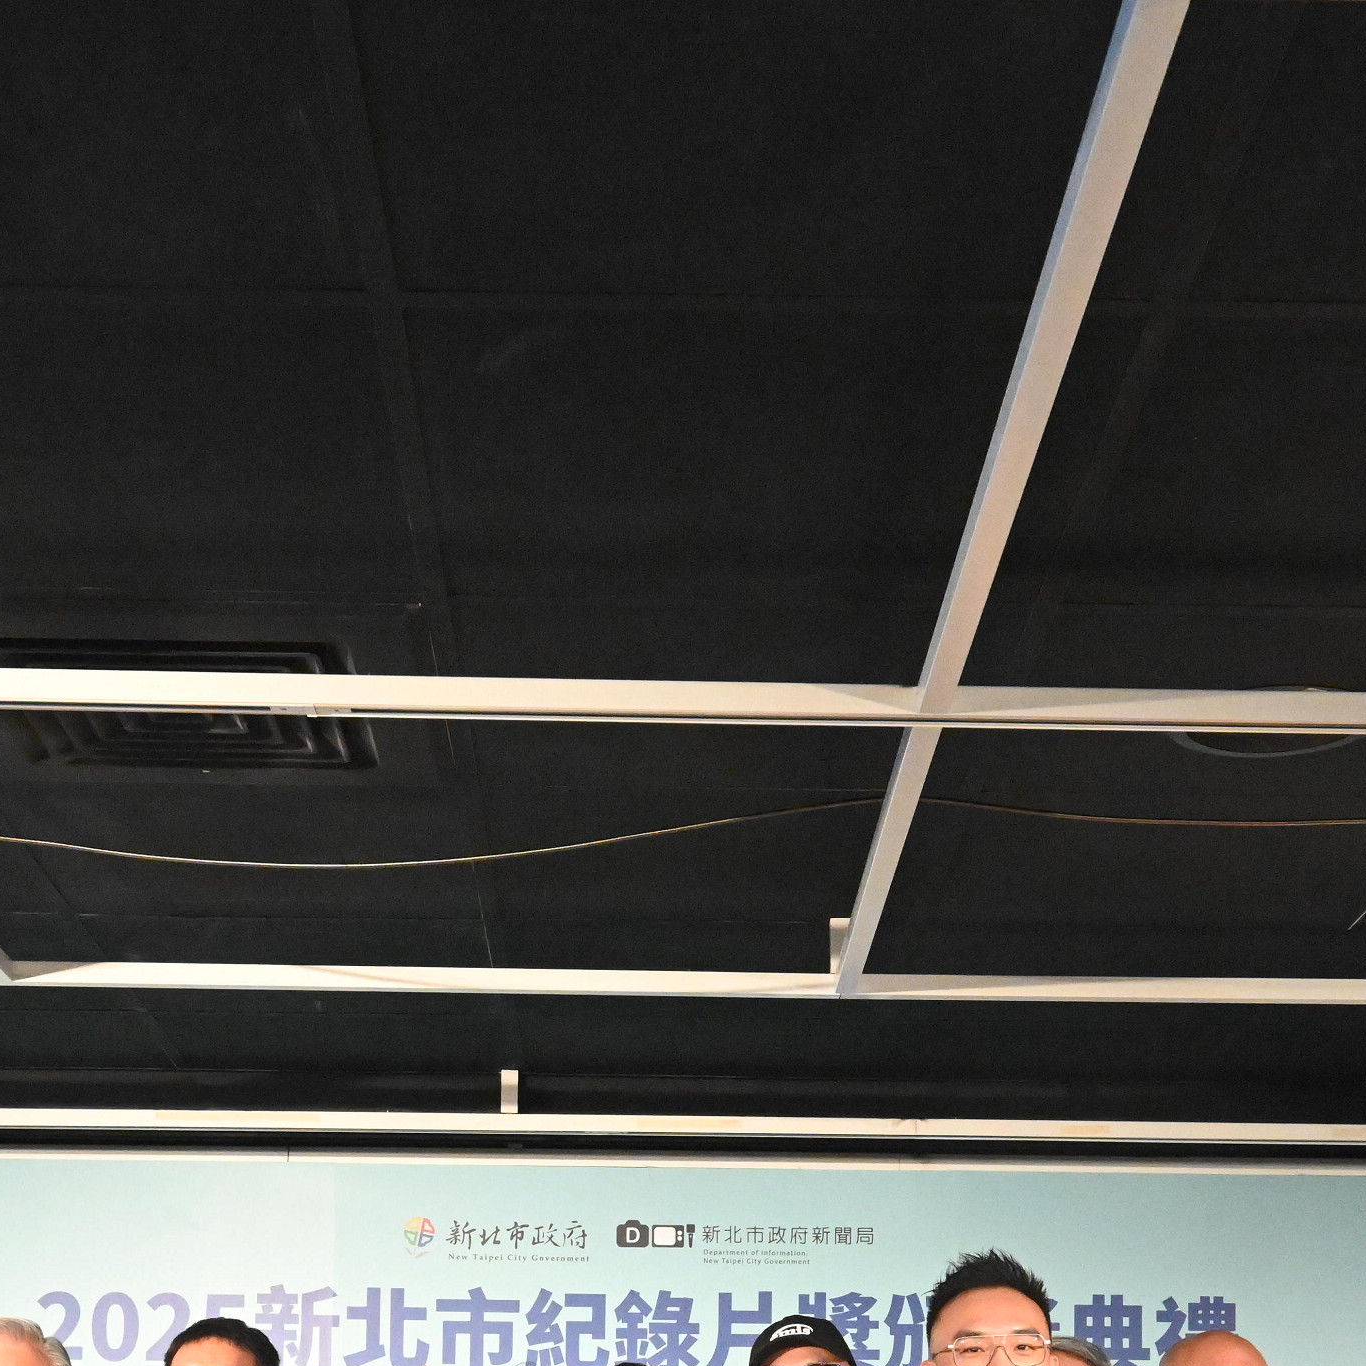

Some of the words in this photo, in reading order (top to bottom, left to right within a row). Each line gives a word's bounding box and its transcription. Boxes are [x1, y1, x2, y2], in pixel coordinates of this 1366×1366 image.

[445, 1219, 588, 1250] 新北市政府
[702, 1224, 875, 1246] 新北市政府新聞局
[448, 1253, 468, 1261] New
[472, 1253, 503, 1263] Taipei
[507, 1253, 528, 1263] City
[531, 1254, 590, 1263] Government
[703, 1257, 719, 1265] New
[722, 1257, 744, 1266] Taipei
[746, 1257, 762, 1266] City
[764, 1257, 811, 1266] Government
